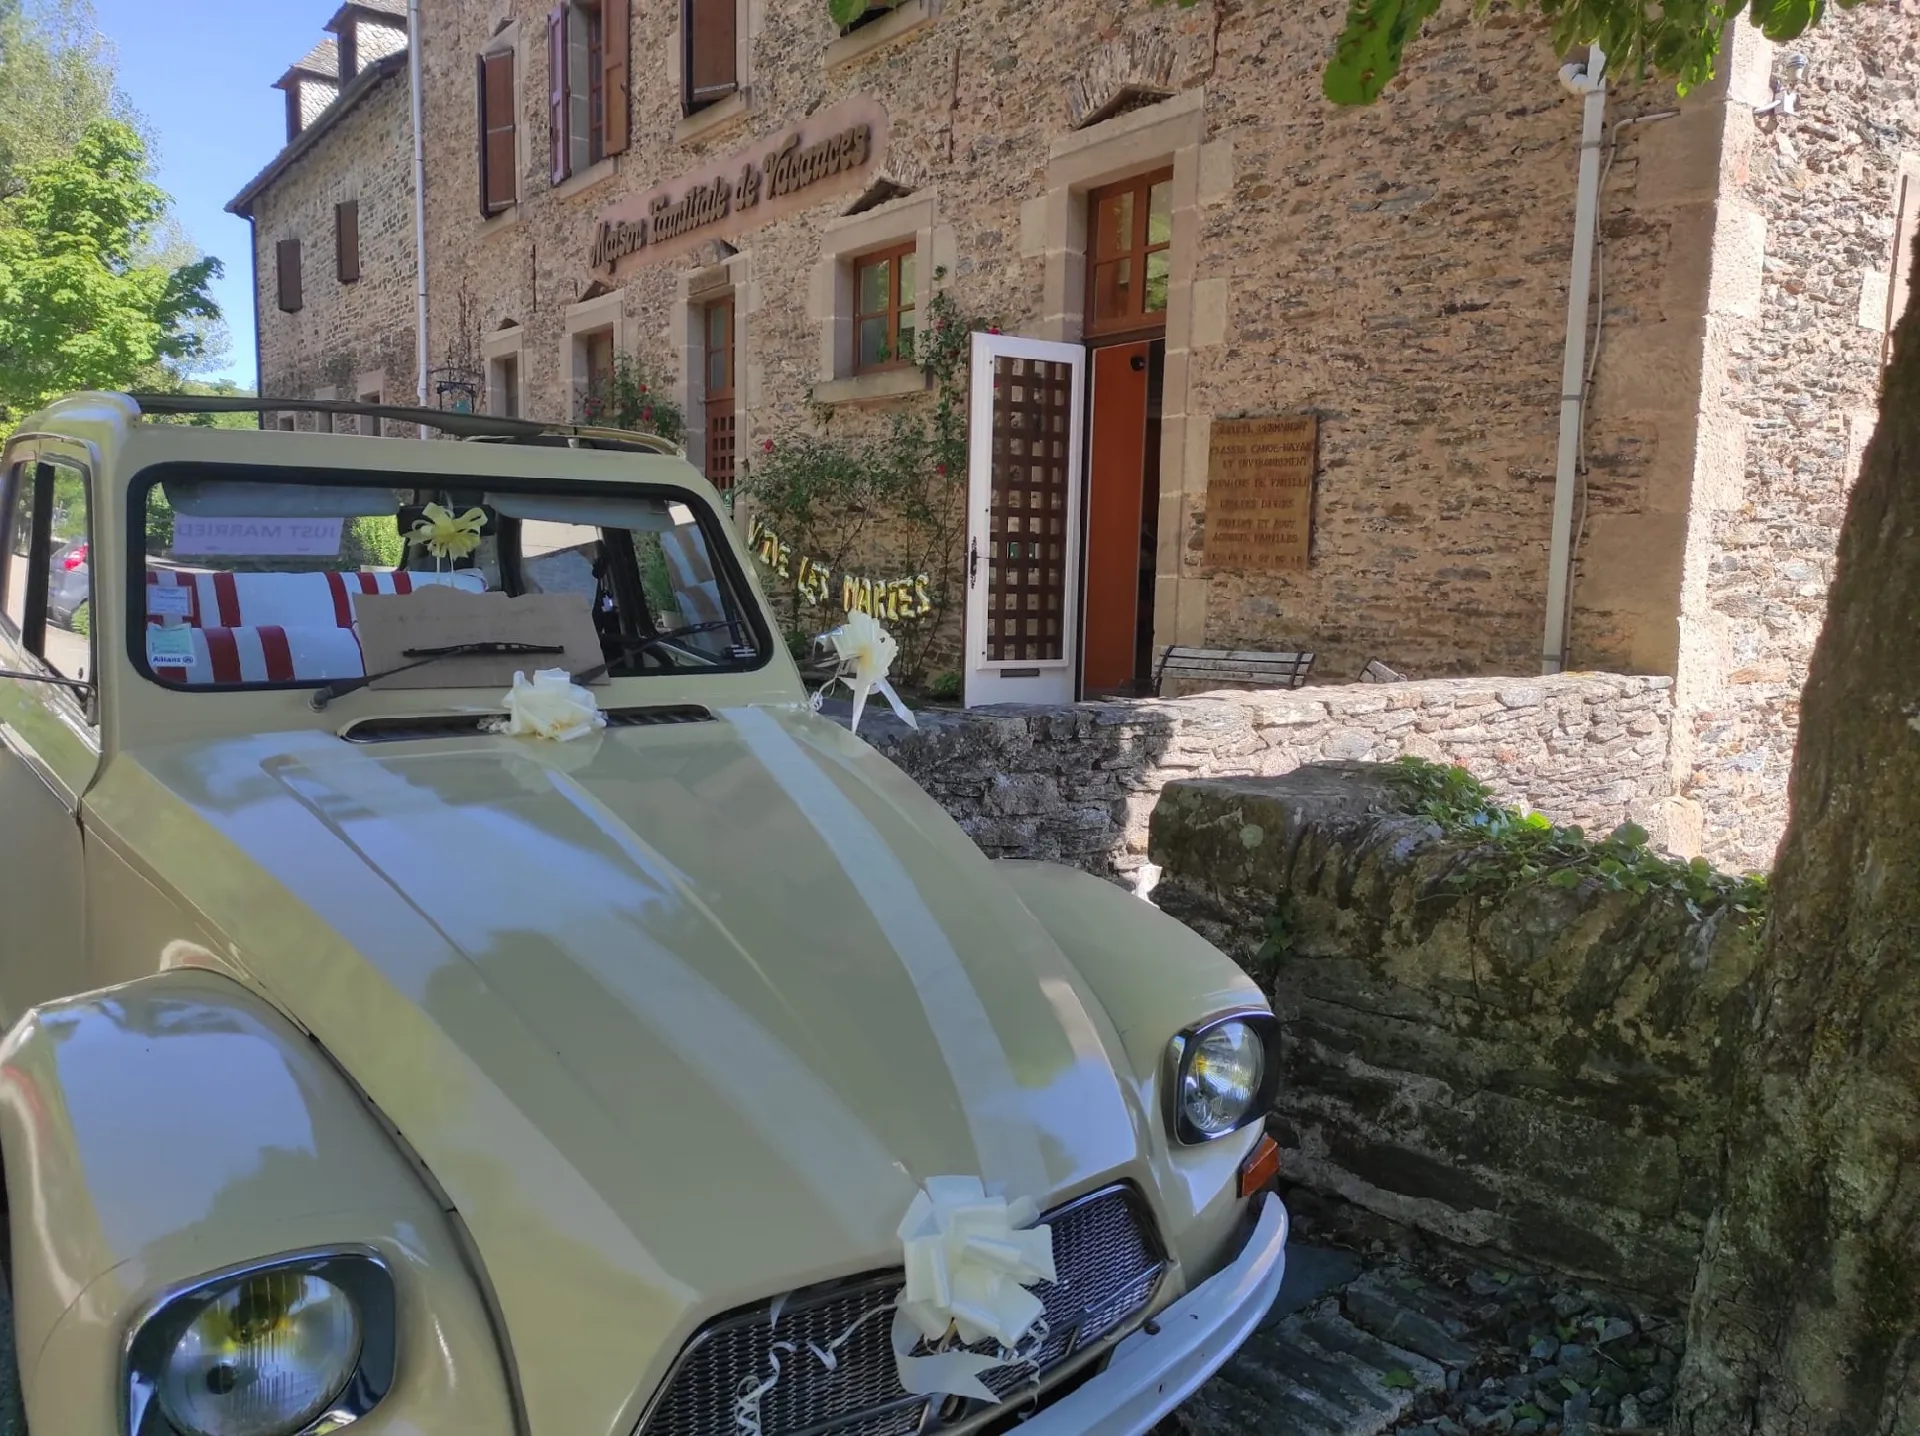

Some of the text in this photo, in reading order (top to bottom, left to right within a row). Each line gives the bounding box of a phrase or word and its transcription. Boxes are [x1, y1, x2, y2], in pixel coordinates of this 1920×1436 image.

[589, 123, 871, 275] Maison Familiale de Vacances
[153, 655, 182, 663] Allianz
